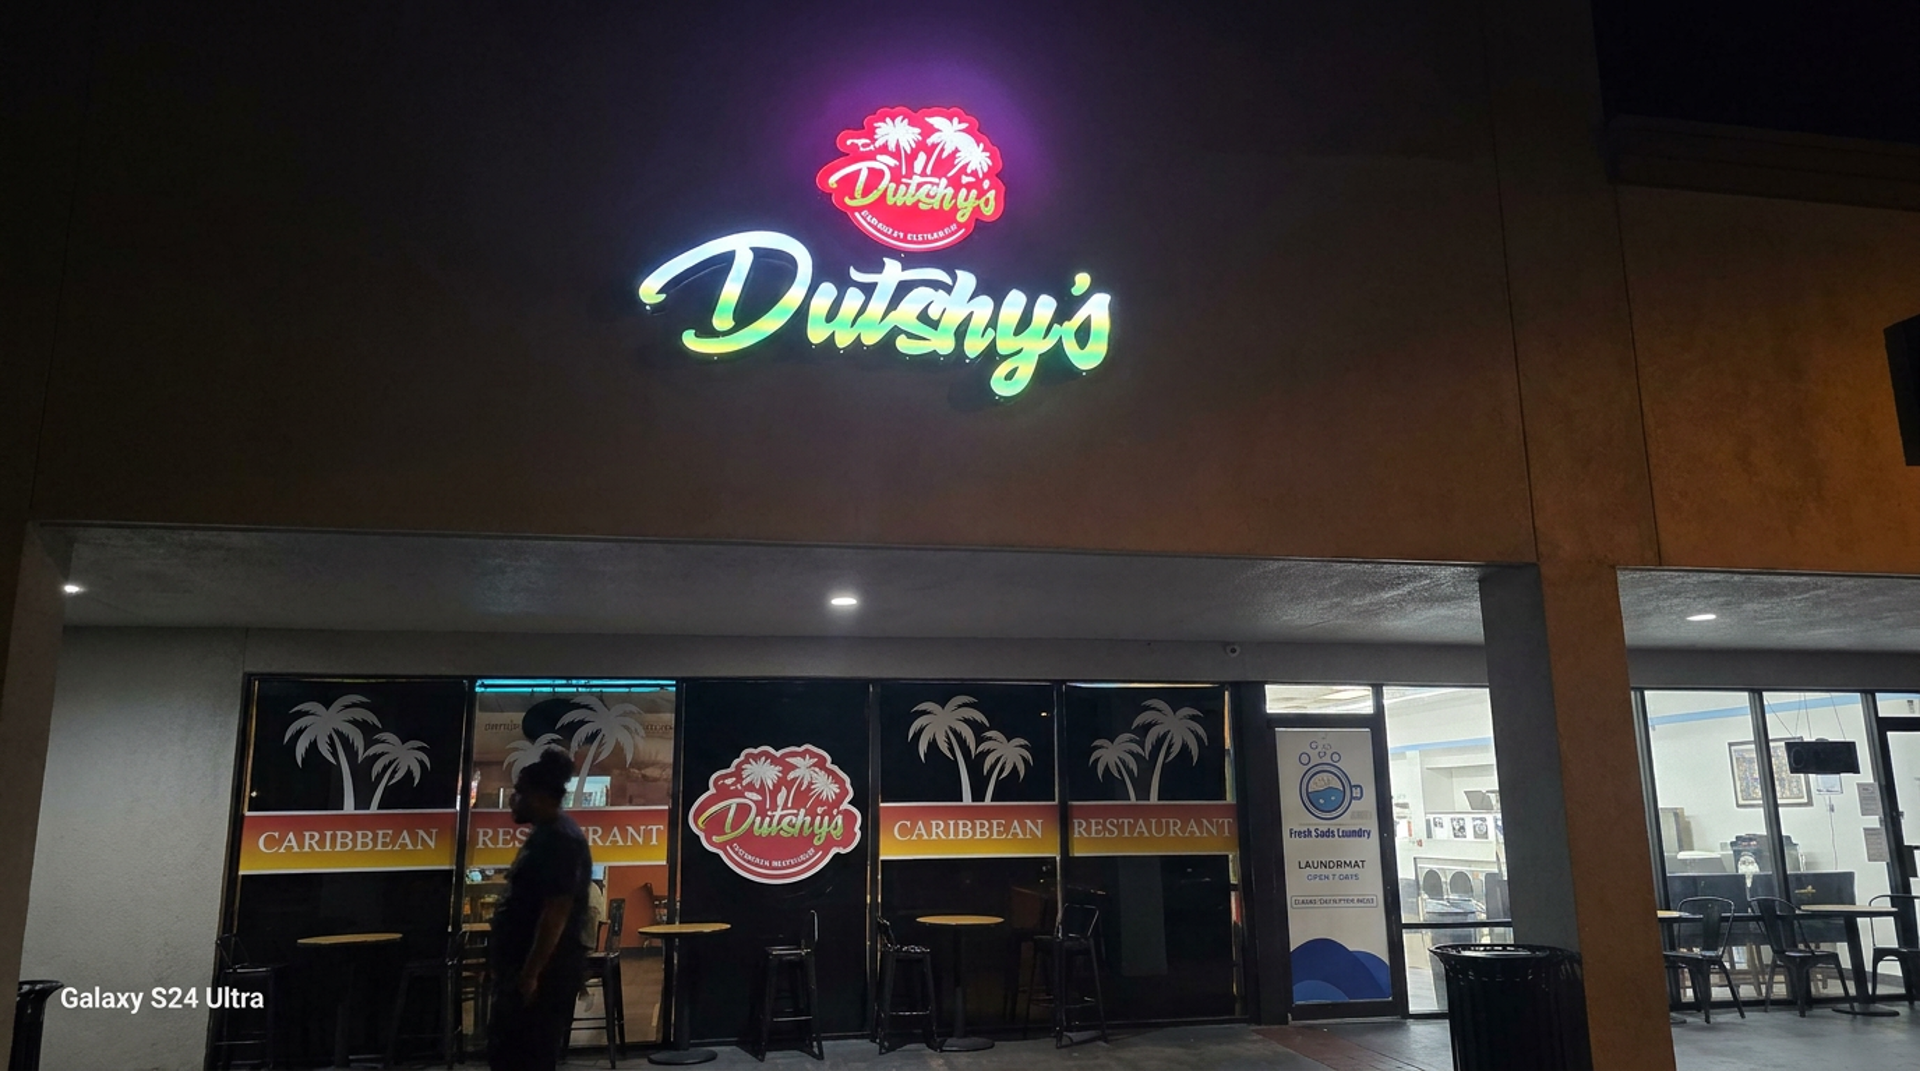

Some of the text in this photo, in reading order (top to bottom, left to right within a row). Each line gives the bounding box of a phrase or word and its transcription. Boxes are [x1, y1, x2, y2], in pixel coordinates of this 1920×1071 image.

[476, 825, 663, 849] RESRANT
[894, 820, 1043, 840] CARIBBEAN
[1073, 818, 1233, 838] RESTAURANT
[1289, 828, 1312, 838] Fresh
[258, 829, 438, 853] CARIBBEAN
